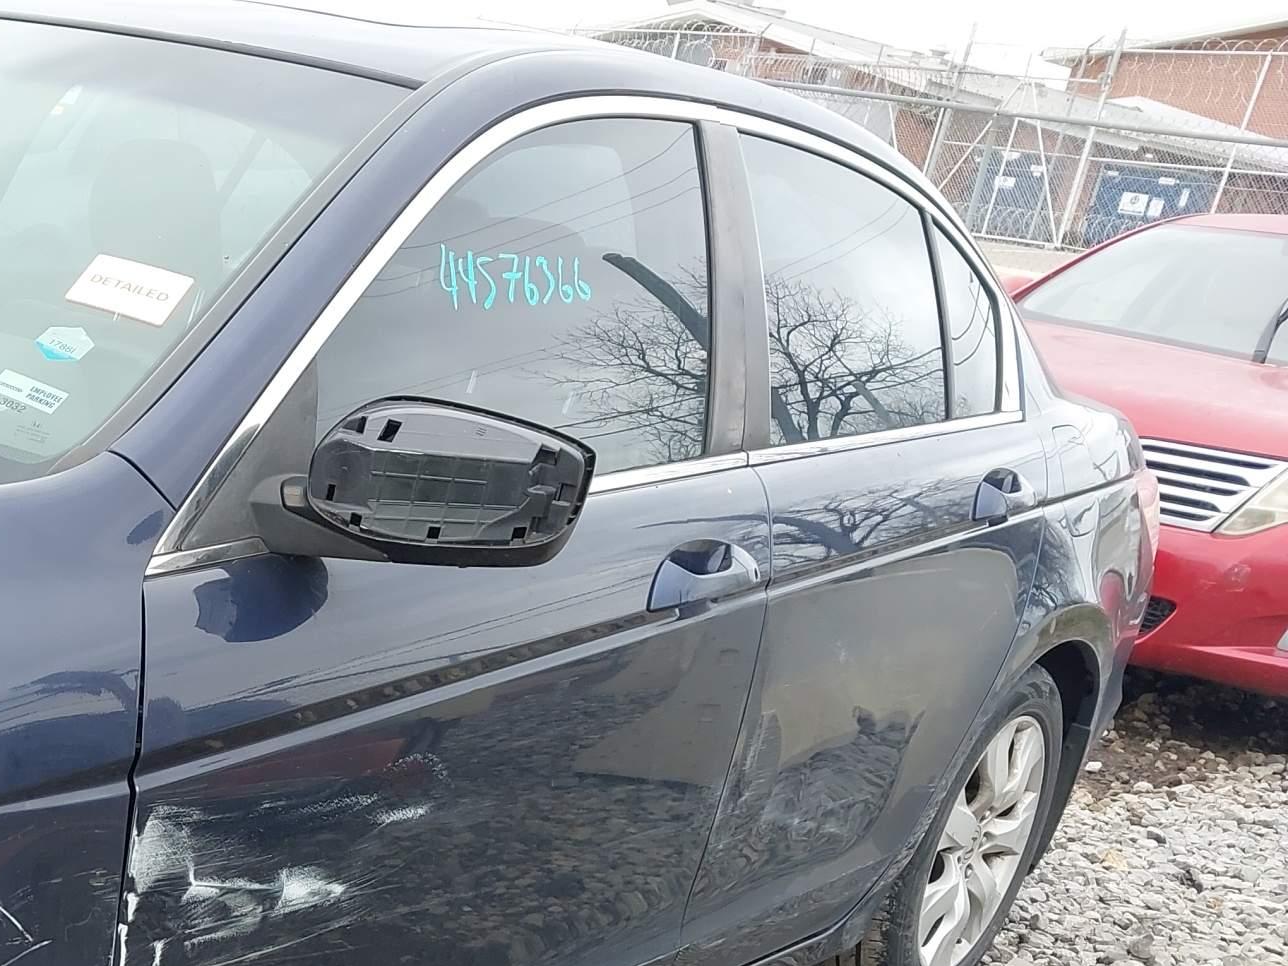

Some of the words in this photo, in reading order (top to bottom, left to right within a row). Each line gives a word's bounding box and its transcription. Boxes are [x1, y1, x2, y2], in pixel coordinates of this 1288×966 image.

[90, 273, 170, 302] DETAILED
[439, 243, 591, 311] 44576366
[25, 393, 56, 409] PARKING
[29, 385, 64, 404] EMPLOYEE
